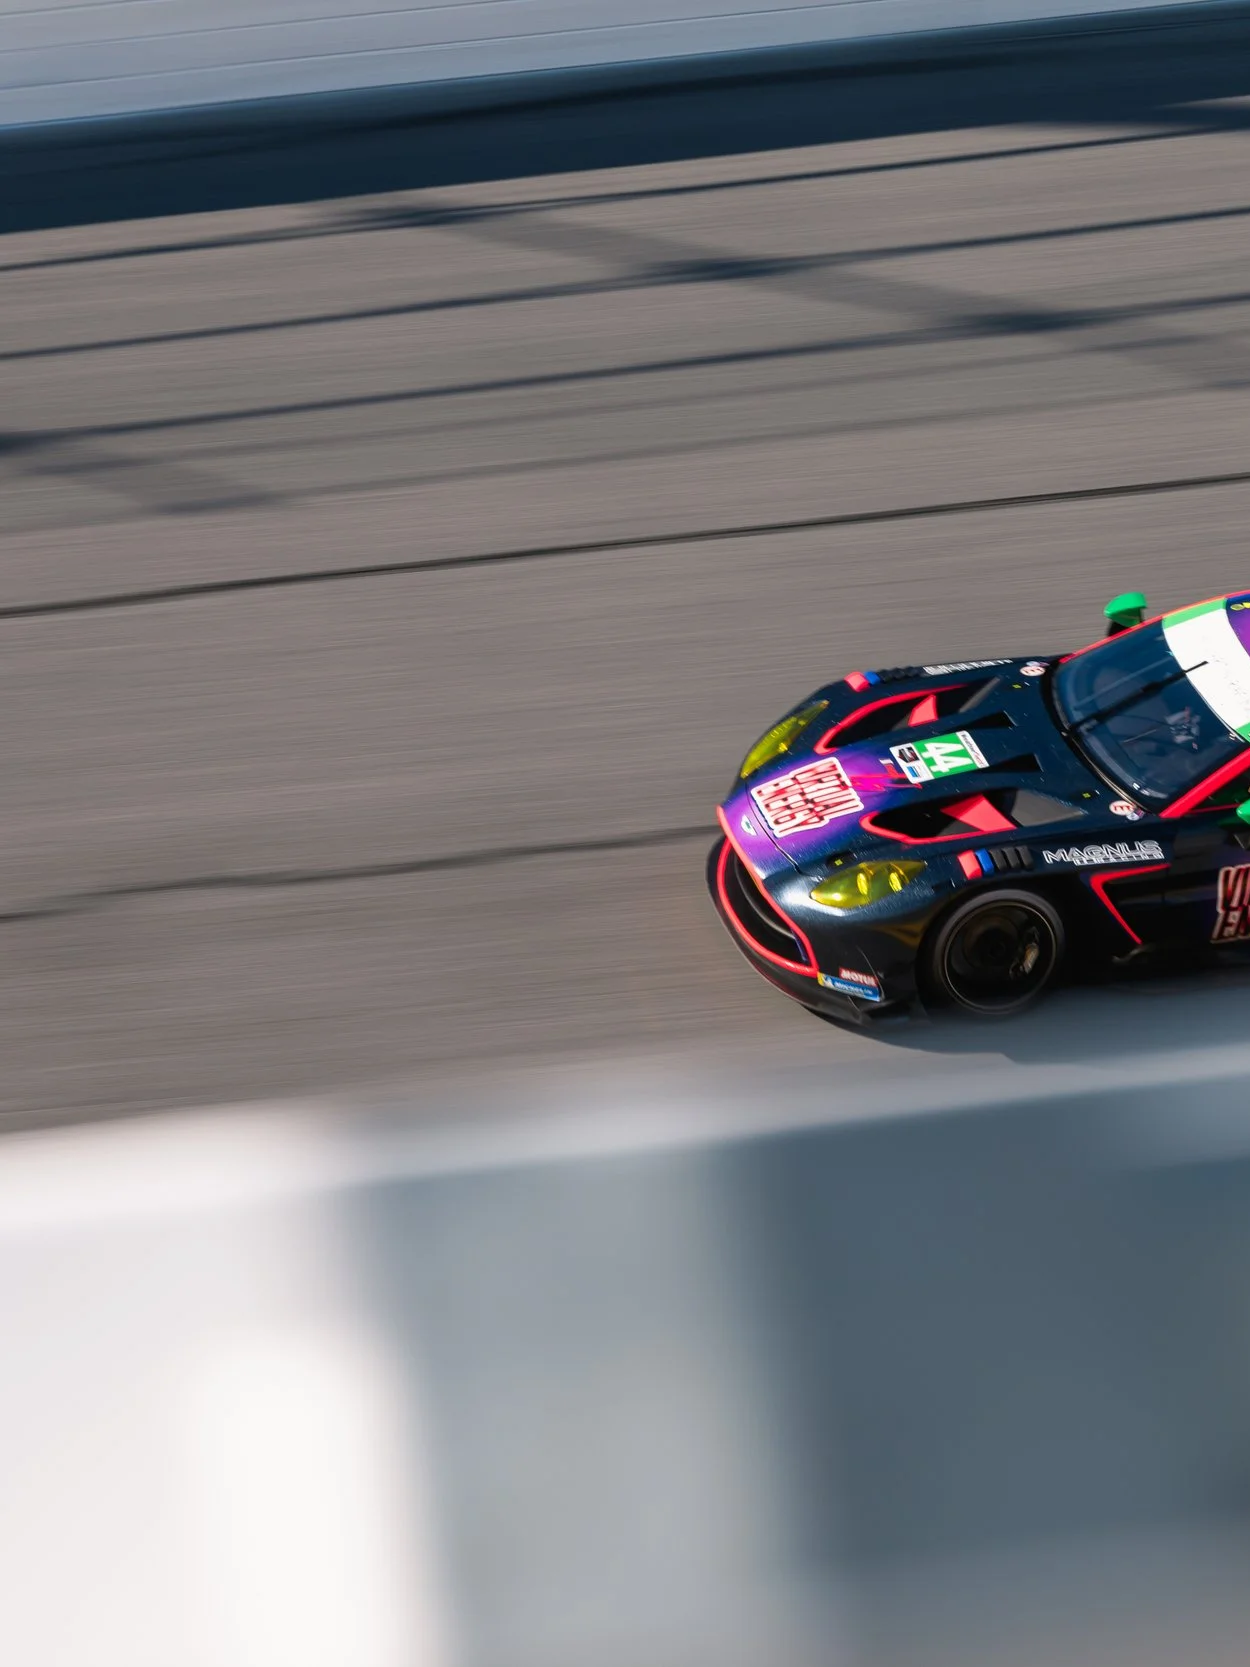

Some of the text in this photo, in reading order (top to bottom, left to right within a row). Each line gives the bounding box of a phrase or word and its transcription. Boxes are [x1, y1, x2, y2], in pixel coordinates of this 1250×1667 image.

[921, 742, 973, 773] 44
[751, 770, 829, 837] ENERGY
[792, 757, 863, 822] VIRTUAL
[1042, 839, 1164, 864] MAGNUS
